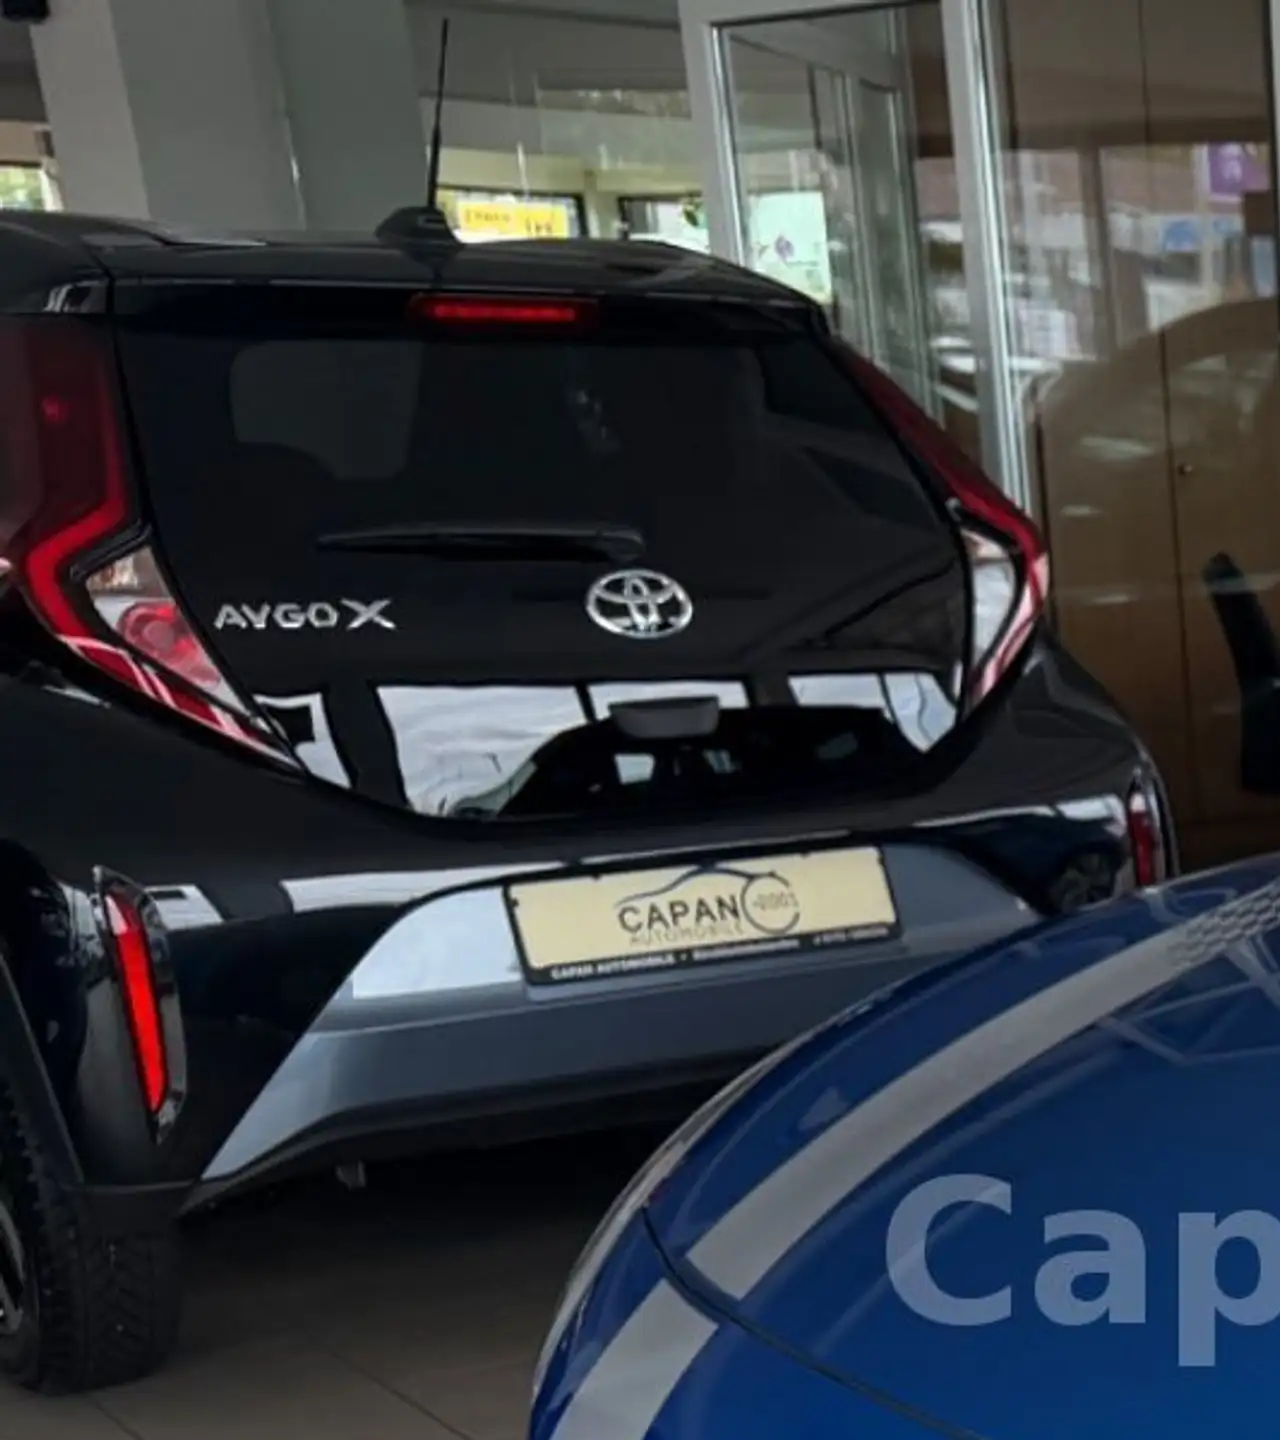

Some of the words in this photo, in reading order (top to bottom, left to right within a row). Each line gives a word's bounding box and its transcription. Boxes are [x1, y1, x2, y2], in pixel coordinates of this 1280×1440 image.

[213, 602, 339, 631] AYGO
[340, 597, 397, 631] X
[617, 893, 742, 934] CAPAN
[629, 921, 745, 946] AUTOMOBILE
